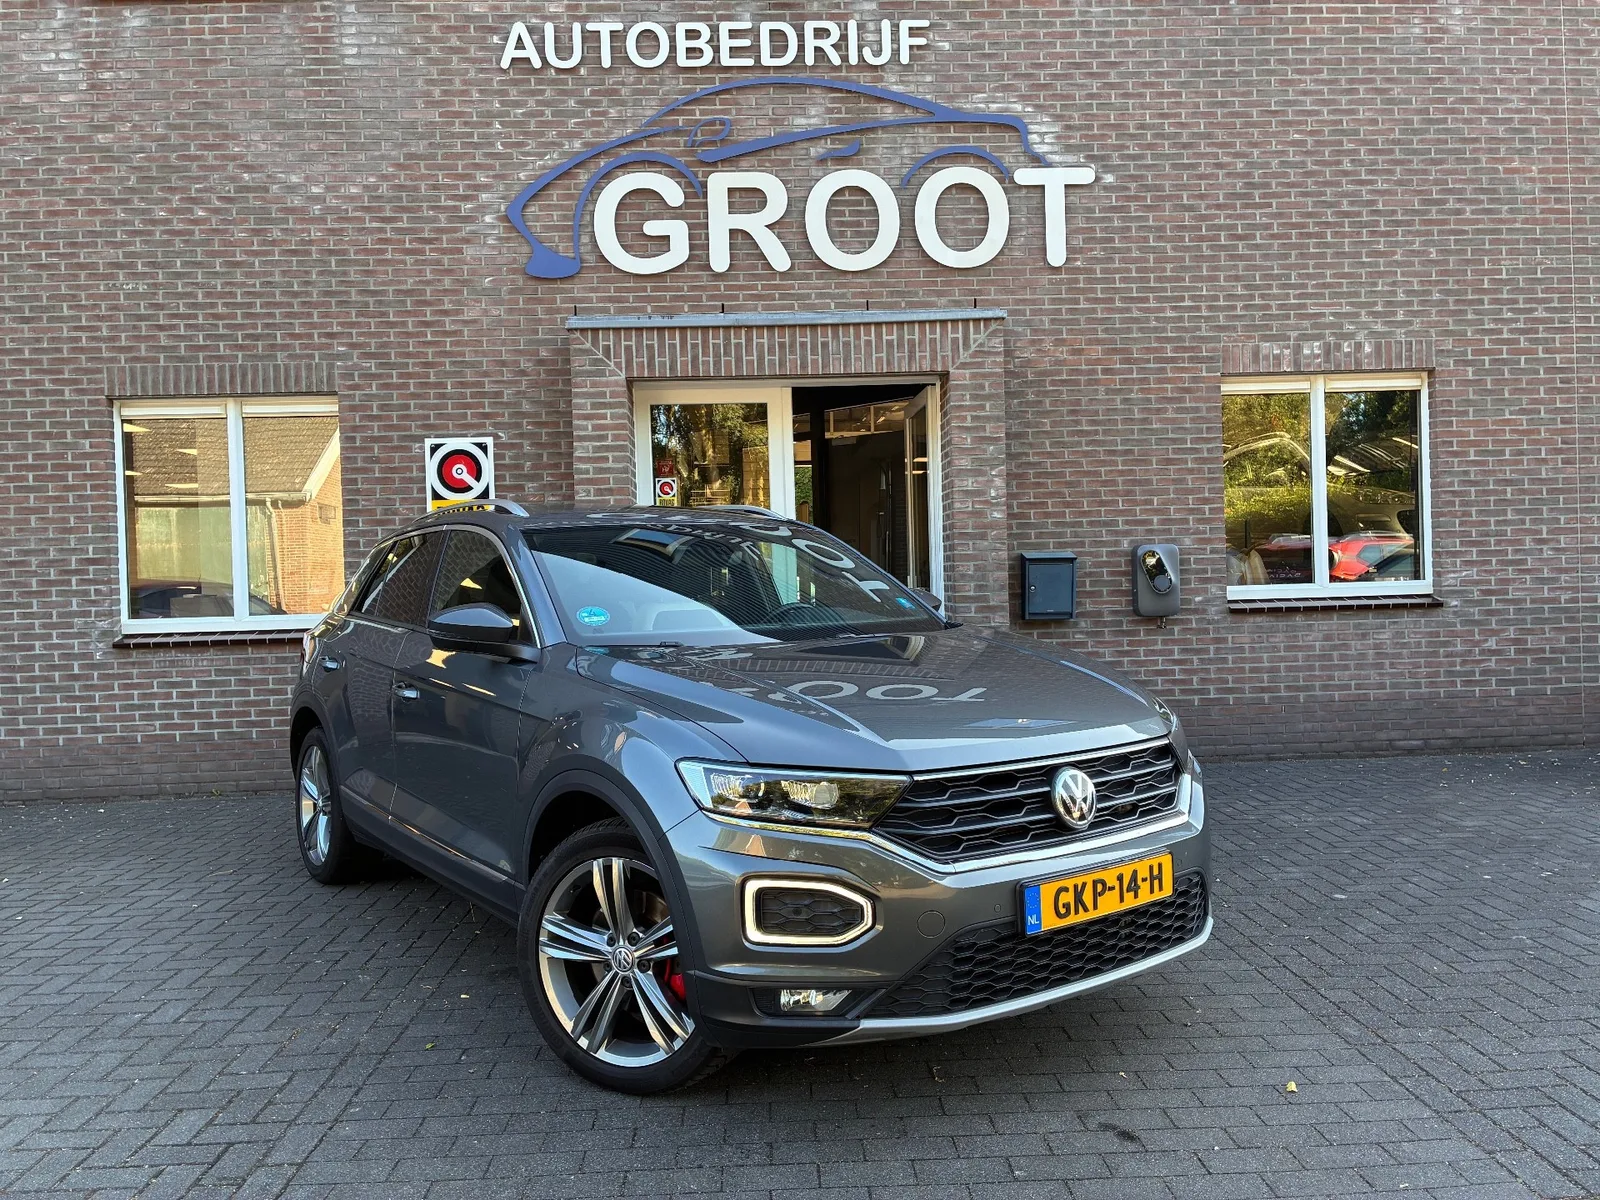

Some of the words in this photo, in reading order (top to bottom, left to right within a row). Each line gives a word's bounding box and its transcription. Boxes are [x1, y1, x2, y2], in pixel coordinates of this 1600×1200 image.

[499, 18, 931, 70] AUTOBEDRIJF
[592, 166, 1096, 275] GROOT
[1053, 861, 1164, 920] GKP-14-H
[1027, 913, 1040, 926] NL
